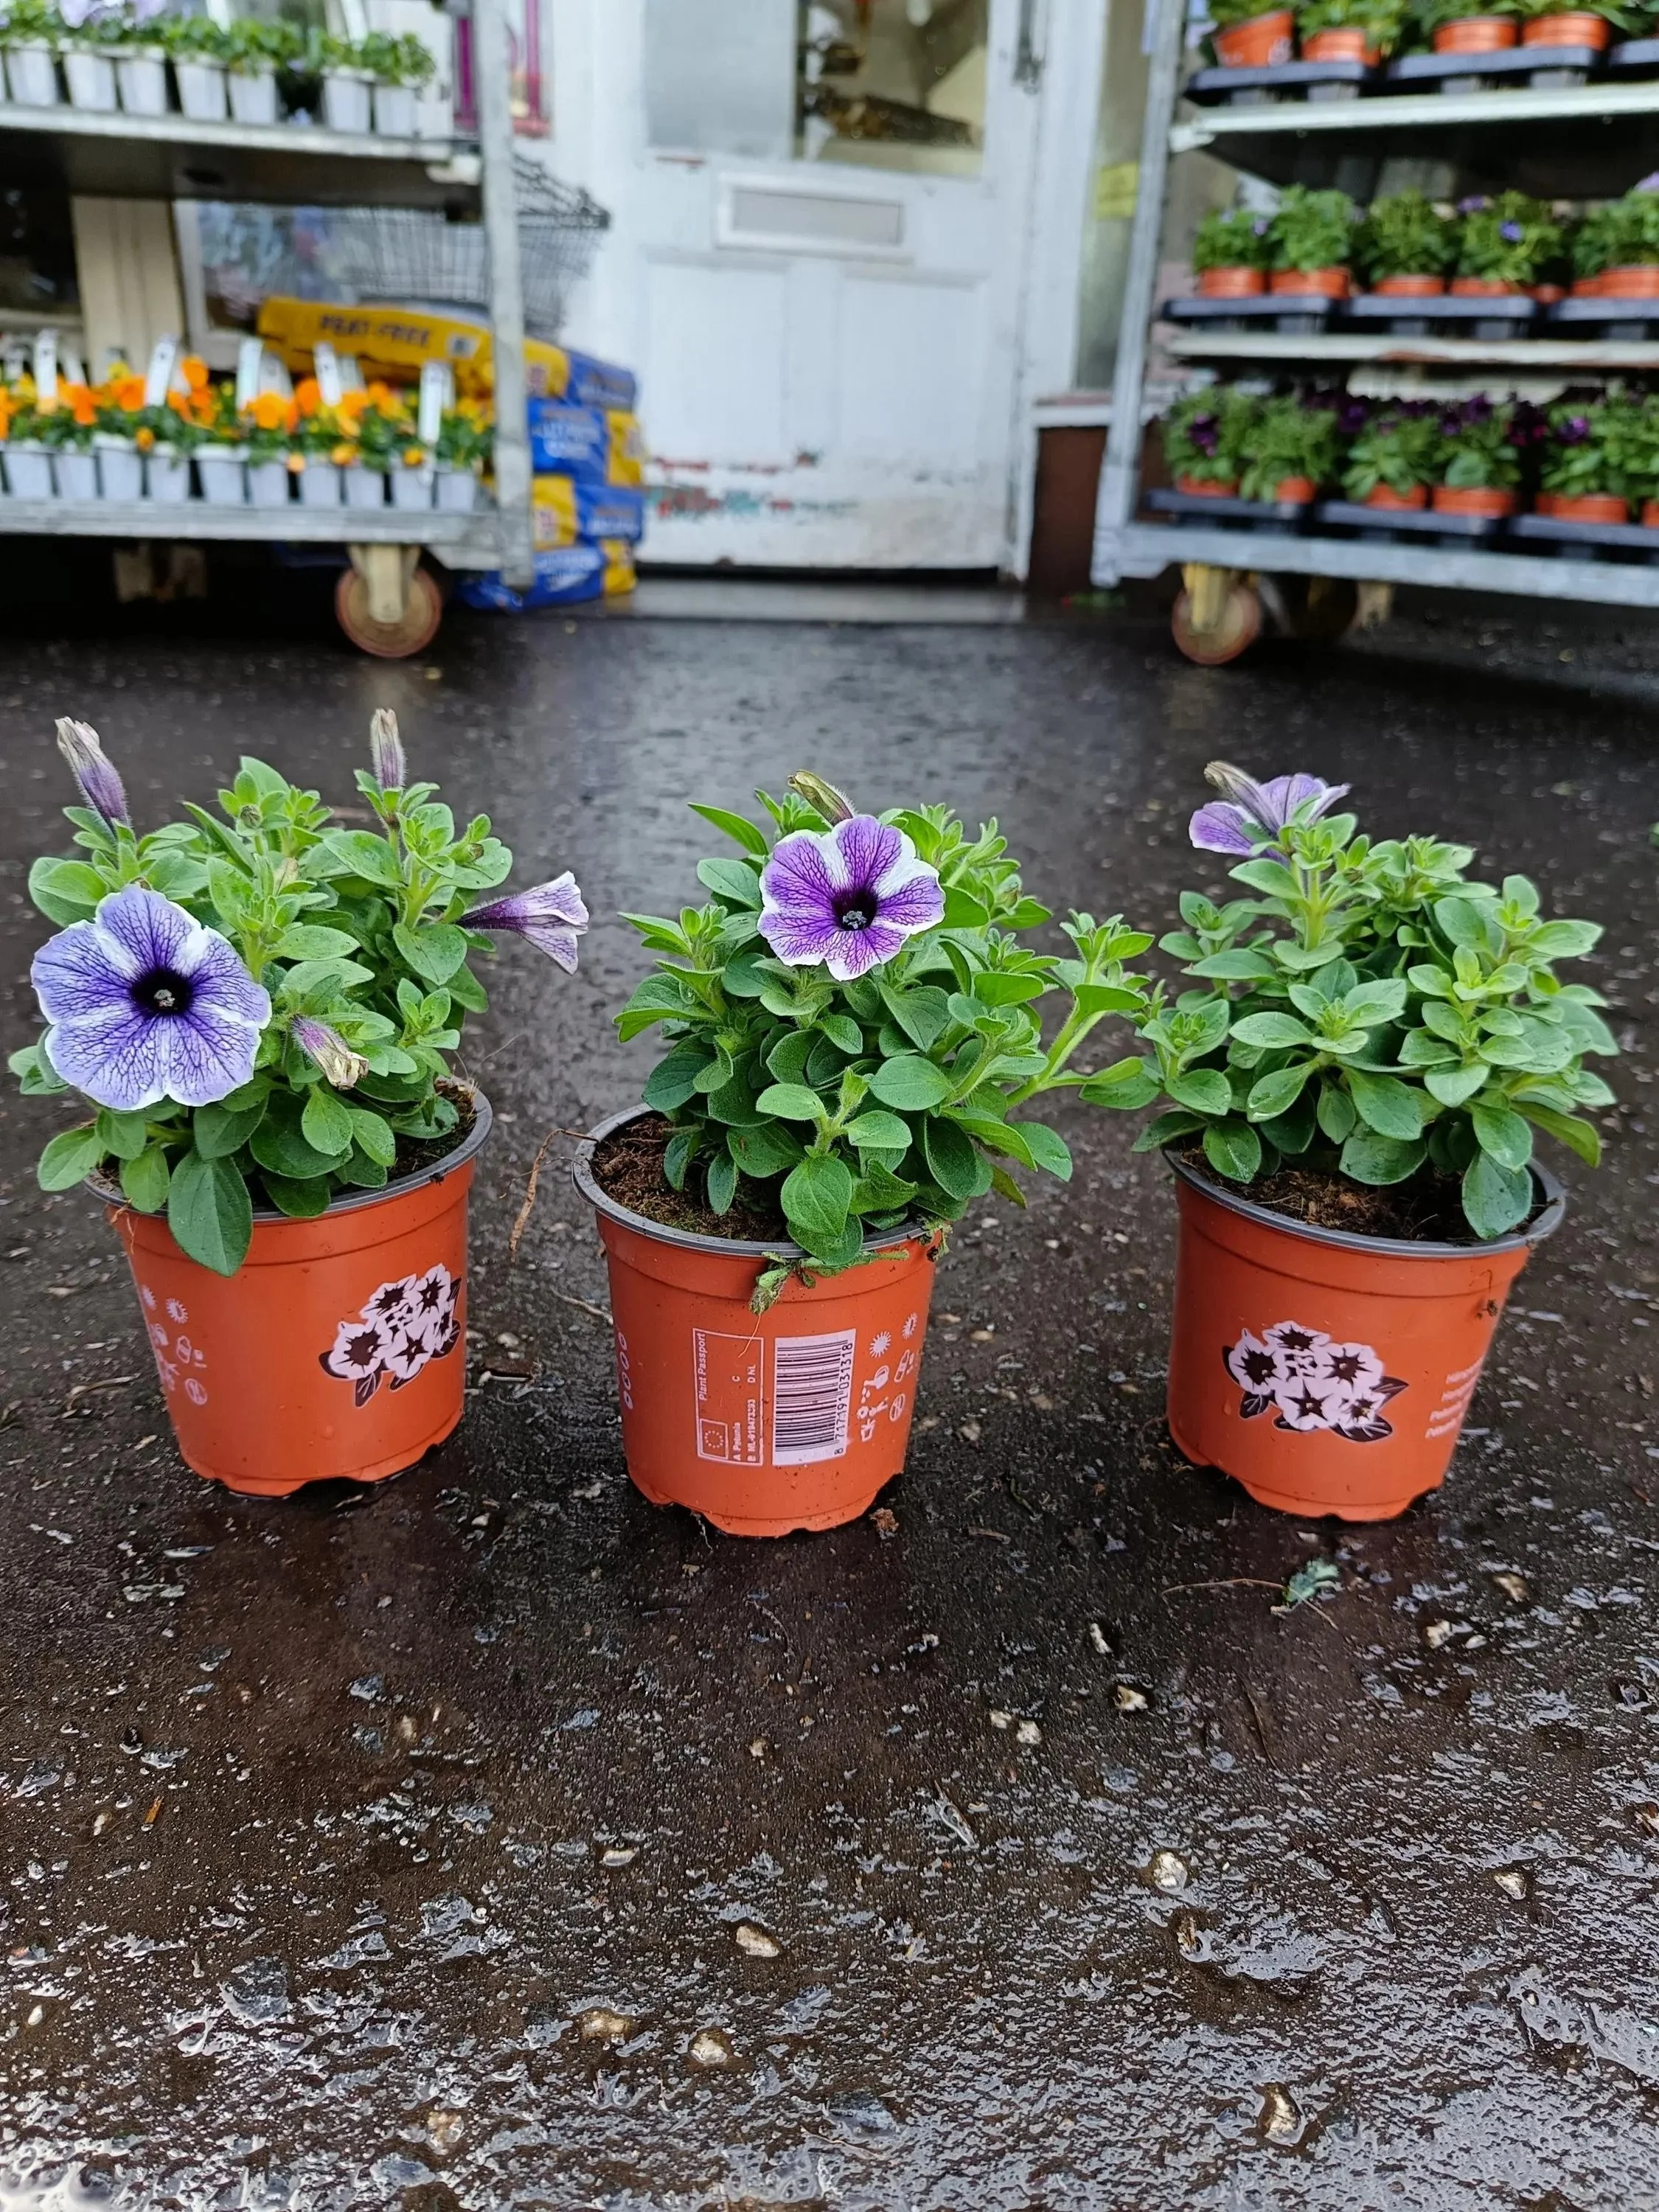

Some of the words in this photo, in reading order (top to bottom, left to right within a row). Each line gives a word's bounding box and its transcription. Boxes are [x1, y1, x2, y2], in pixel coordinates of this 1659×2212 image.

[697, 1332, 708, 1376] Passport
[838, 1343, 853, 1390] 031318
[698, 1377, 707, 1401] Plant
[835, 1395, 847, 1439] 717191
